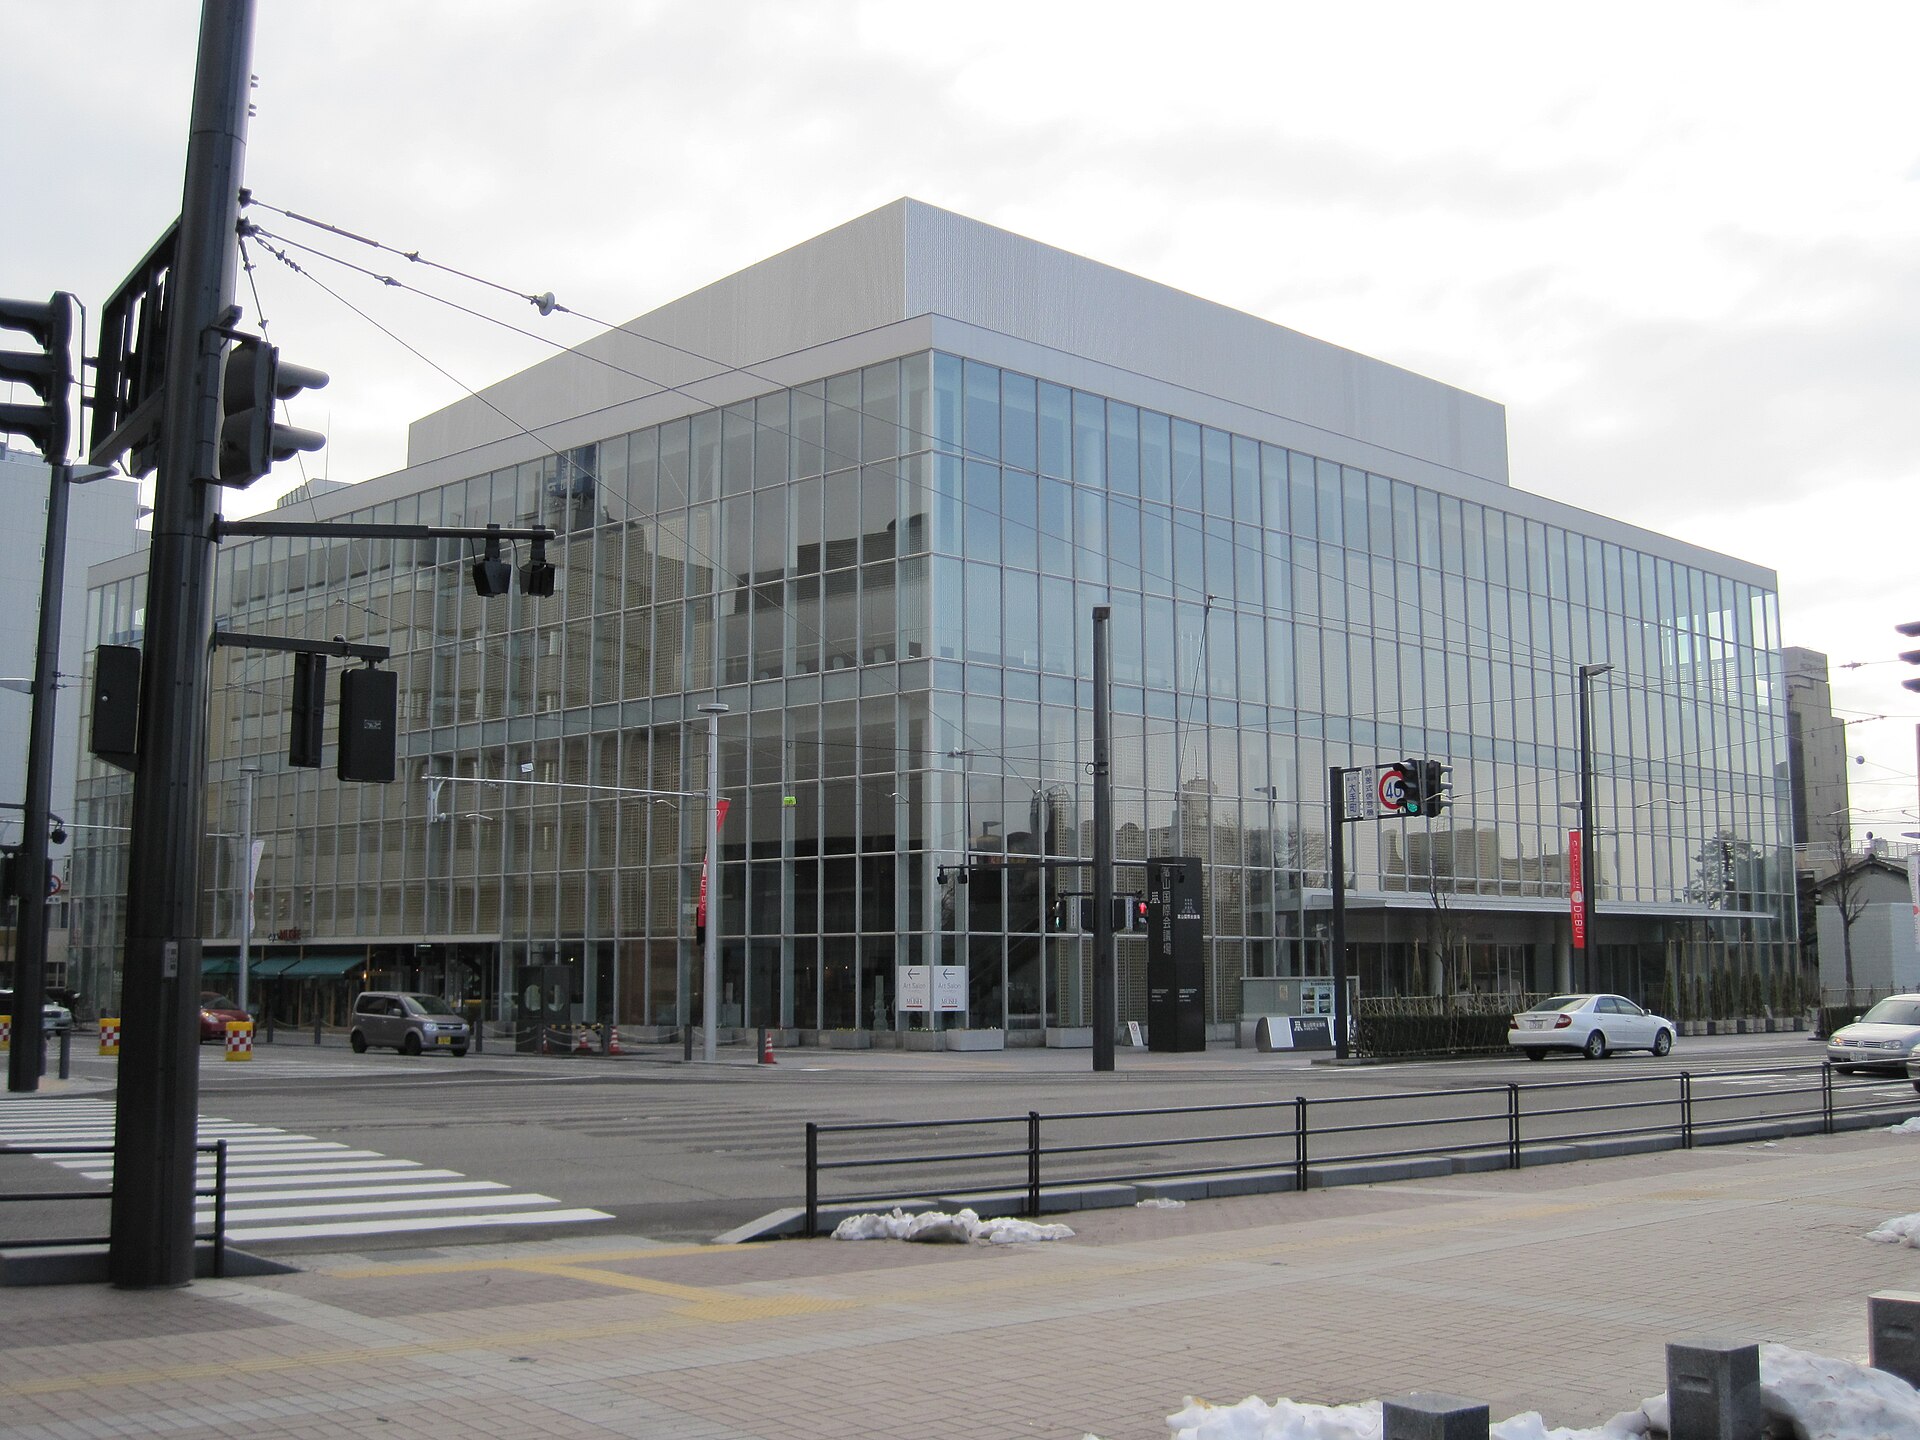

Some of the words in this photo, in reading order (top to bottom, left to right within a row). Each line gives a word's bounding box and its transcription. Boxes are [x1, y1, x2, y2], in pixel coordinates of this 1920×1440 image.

[1348, 783, 1357, 813] 大手町
[1364, 768, 1374, 816] 時差式信号機
[1386, 782, 1403, 799] 40
